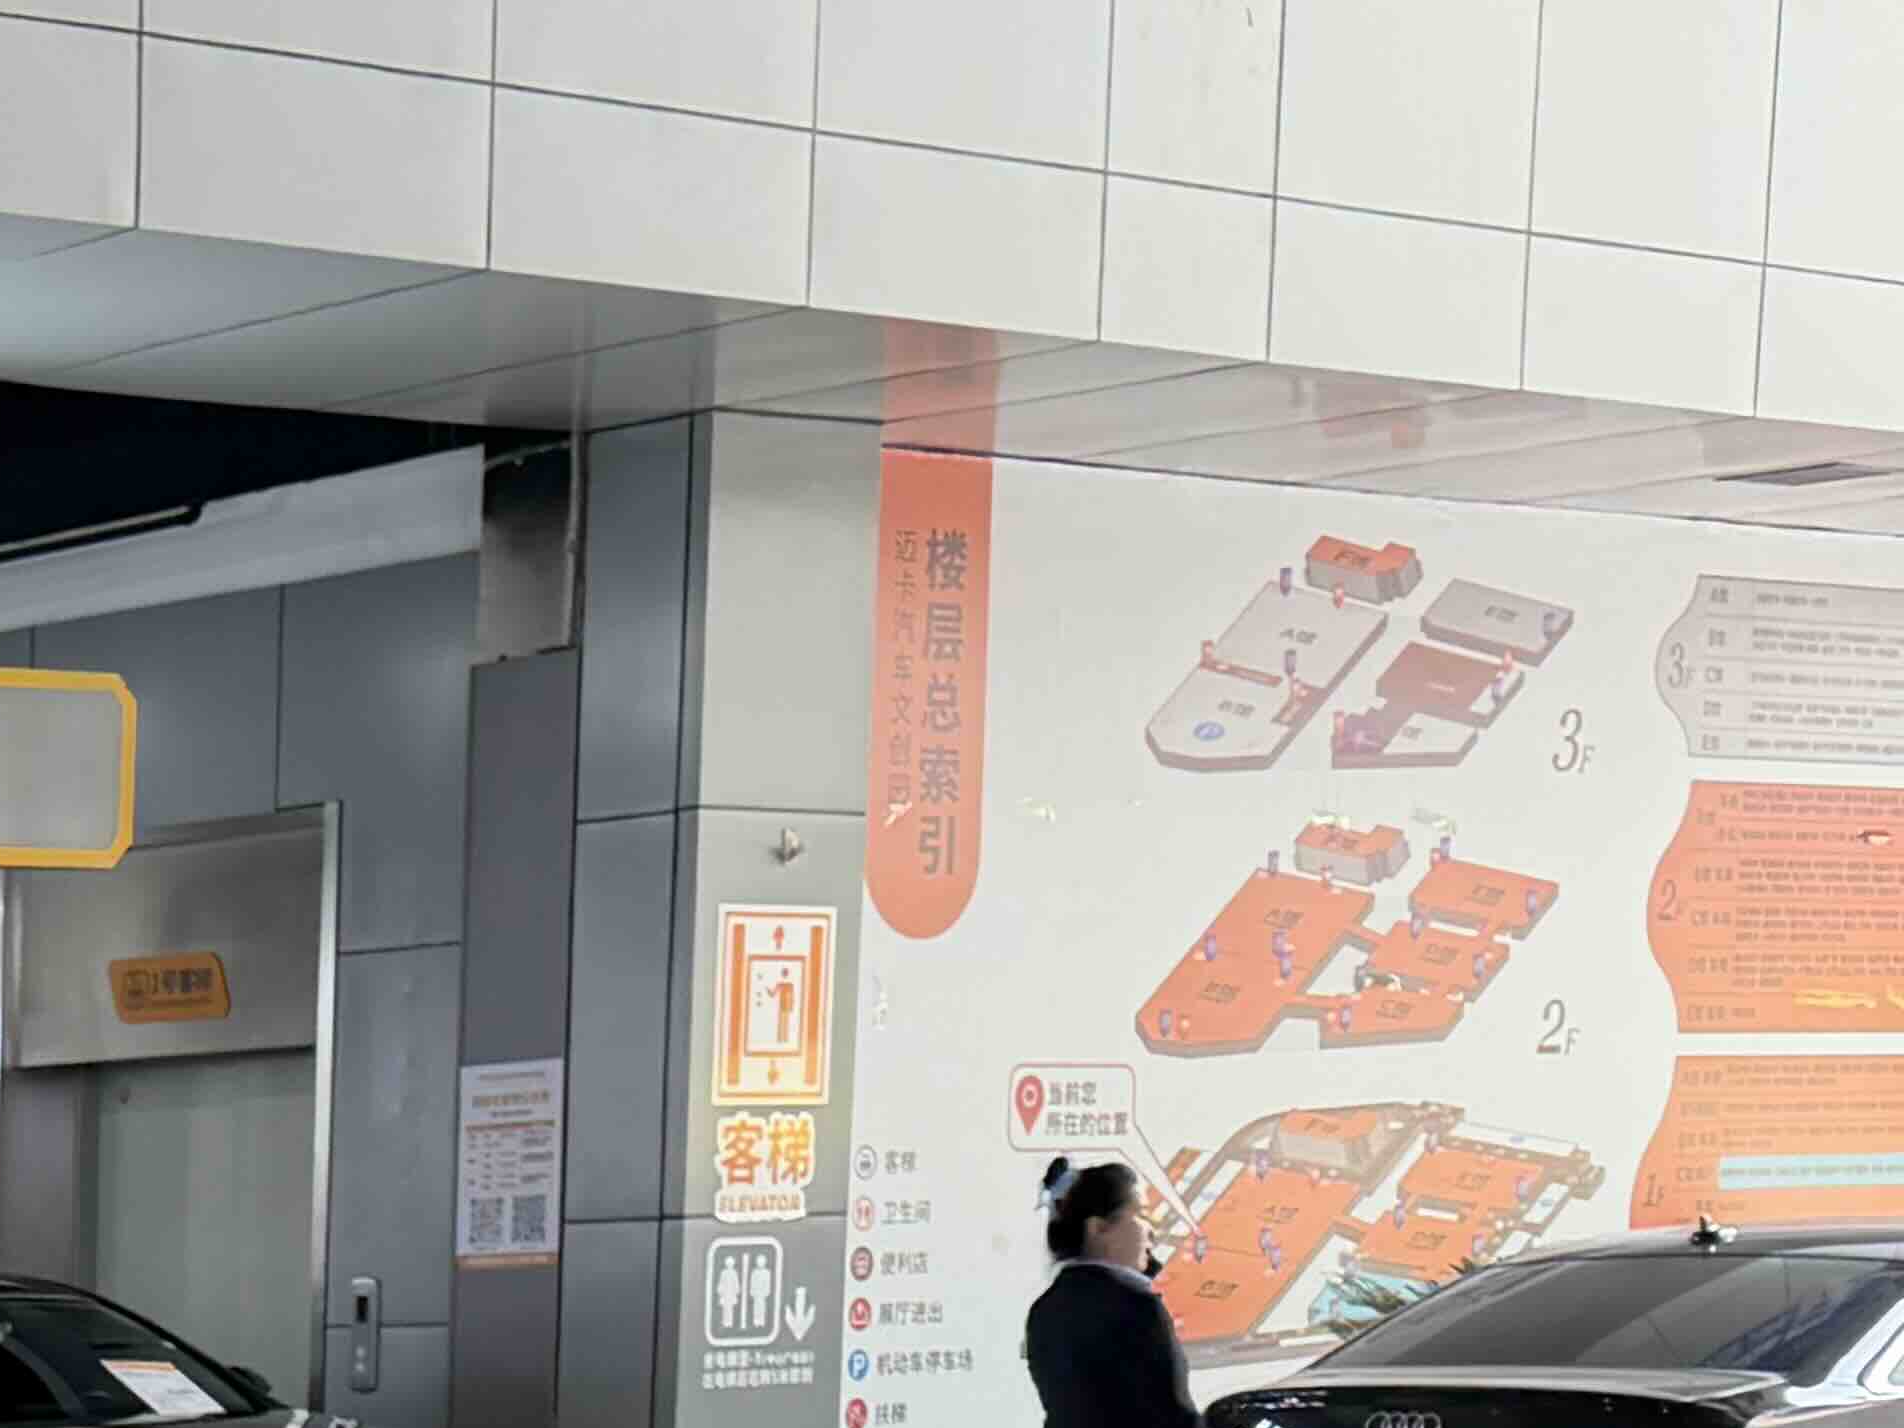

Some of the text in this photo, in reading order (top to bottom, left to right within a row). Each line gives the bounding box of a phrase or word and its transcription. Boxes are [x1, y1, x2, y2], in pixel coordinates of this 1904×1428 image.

[917, 527, 970, 876] 楼层总索引
[720, 1119, 812, 1185] 客梯
